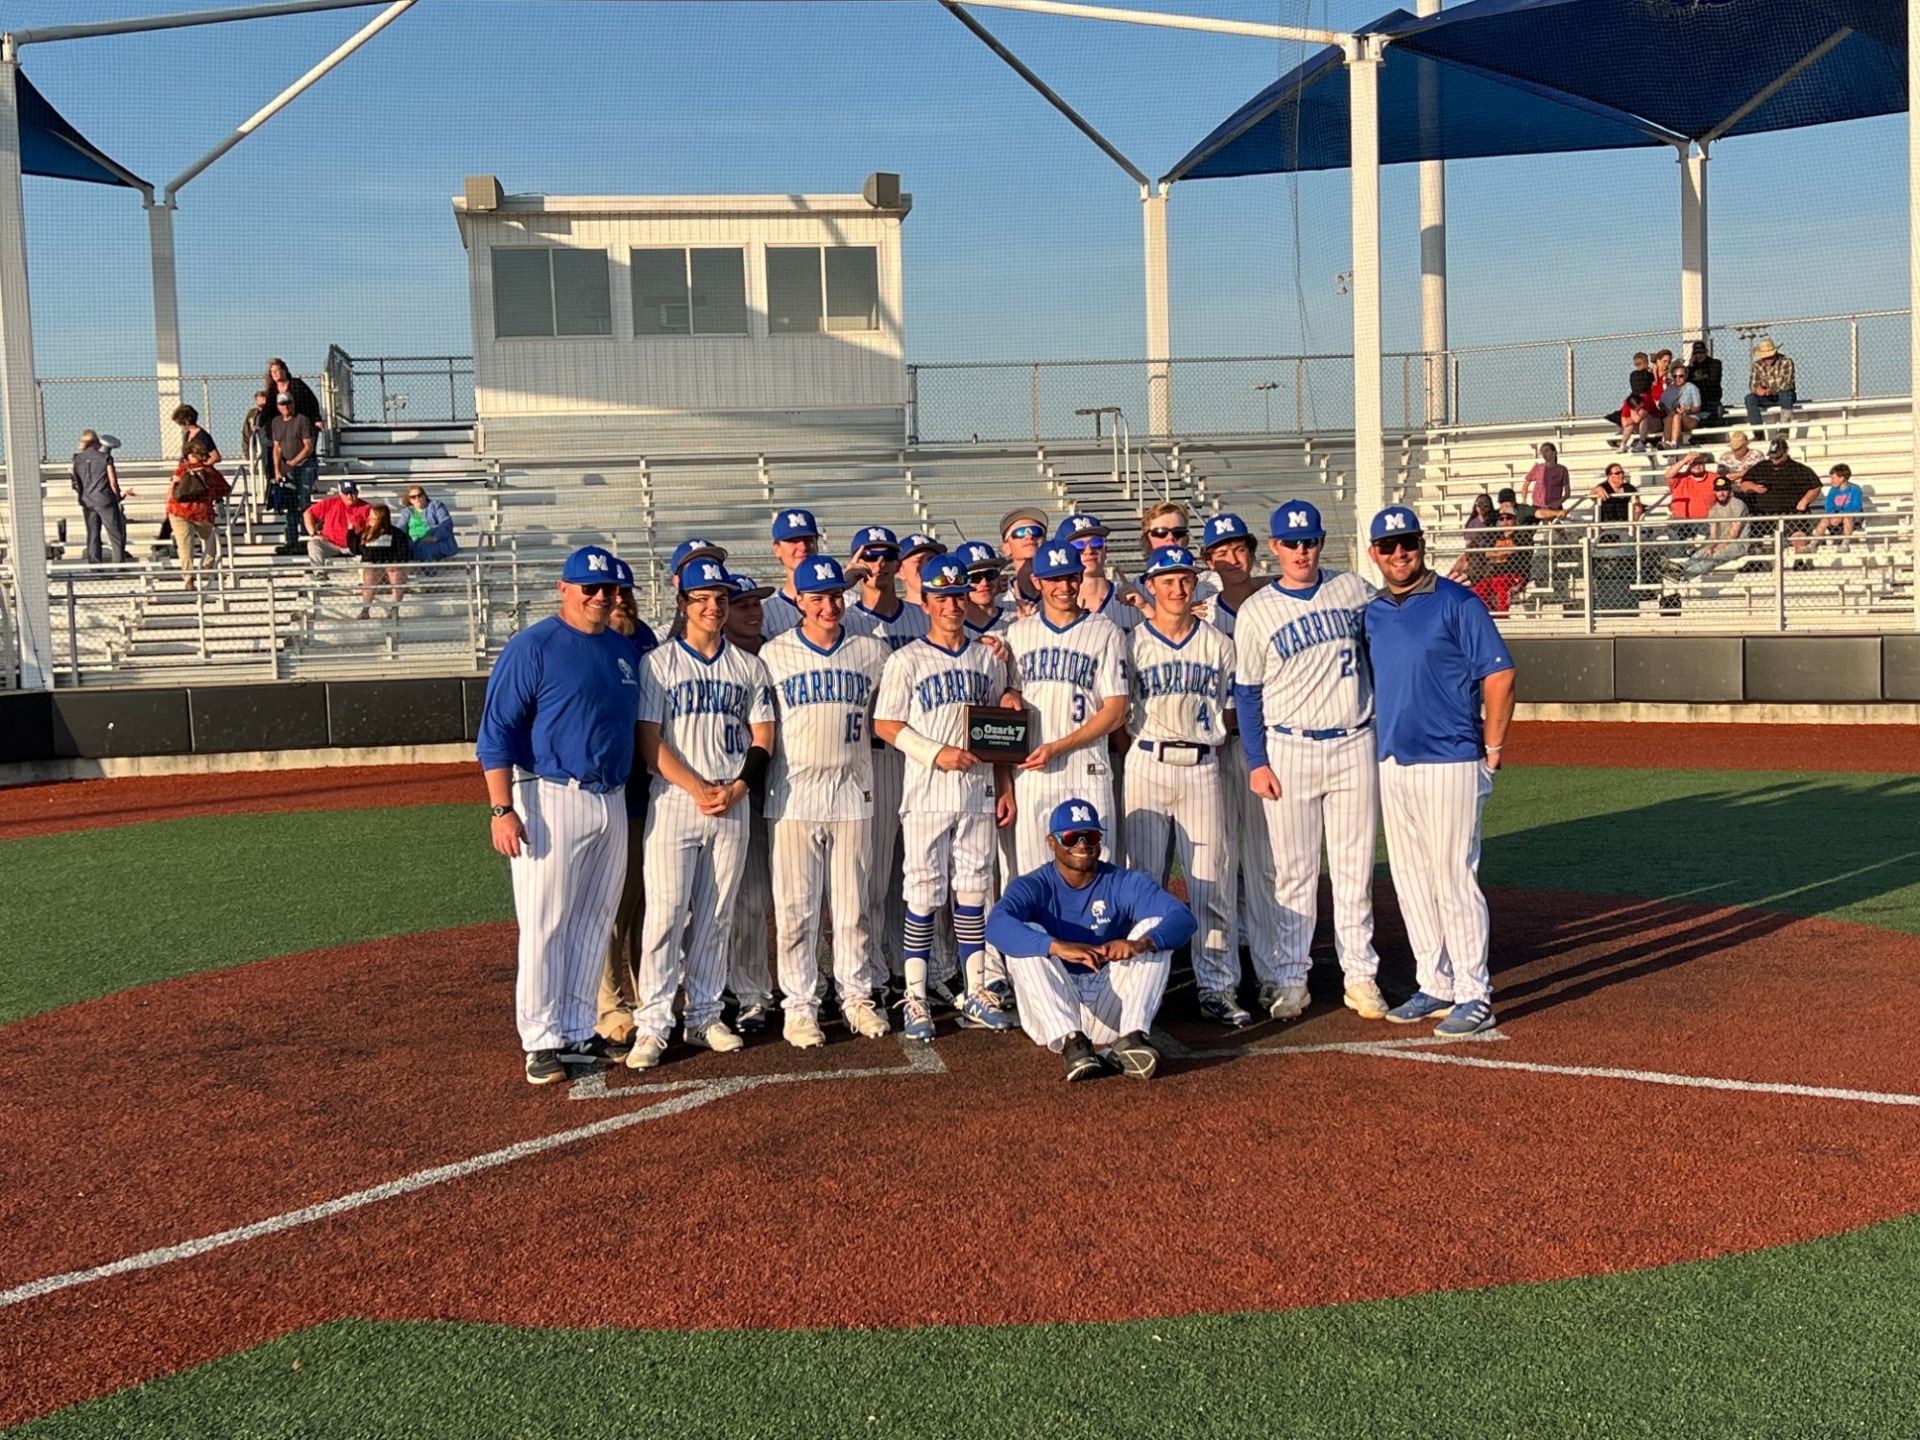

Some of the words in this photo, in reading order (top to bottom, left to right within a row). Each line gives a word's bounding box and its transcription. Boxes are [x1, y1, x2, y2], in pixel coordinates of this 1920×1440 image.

[788, 513, 807, 528] M
[1073, 517, 1092, 531] M
[1213, 518, 1235, 534] M
[1288, 511, 1308, 528] M
[1384, 513, 1406, 531] M
[868, 528, 887, 541] M
[970, 546, 990, 561] M
[1048, 549, 1068, 566] M
[587, 554, 608, 571] M
[702, 564, 722, 580] M
[814, 563, 835, 580] M
[736, 577, 757, 592] M
[915, 668, 993, 714] WARRIOR
[1072, 693, 1087, 723] 3
[1197, 702, 1211, 731] 4
[845, 712, 863, 744] 15
[984, 723, 1015, 735] Ozark
[1015, 726, 1026, 741] 7
[1070, 805, 1091, 822] M
